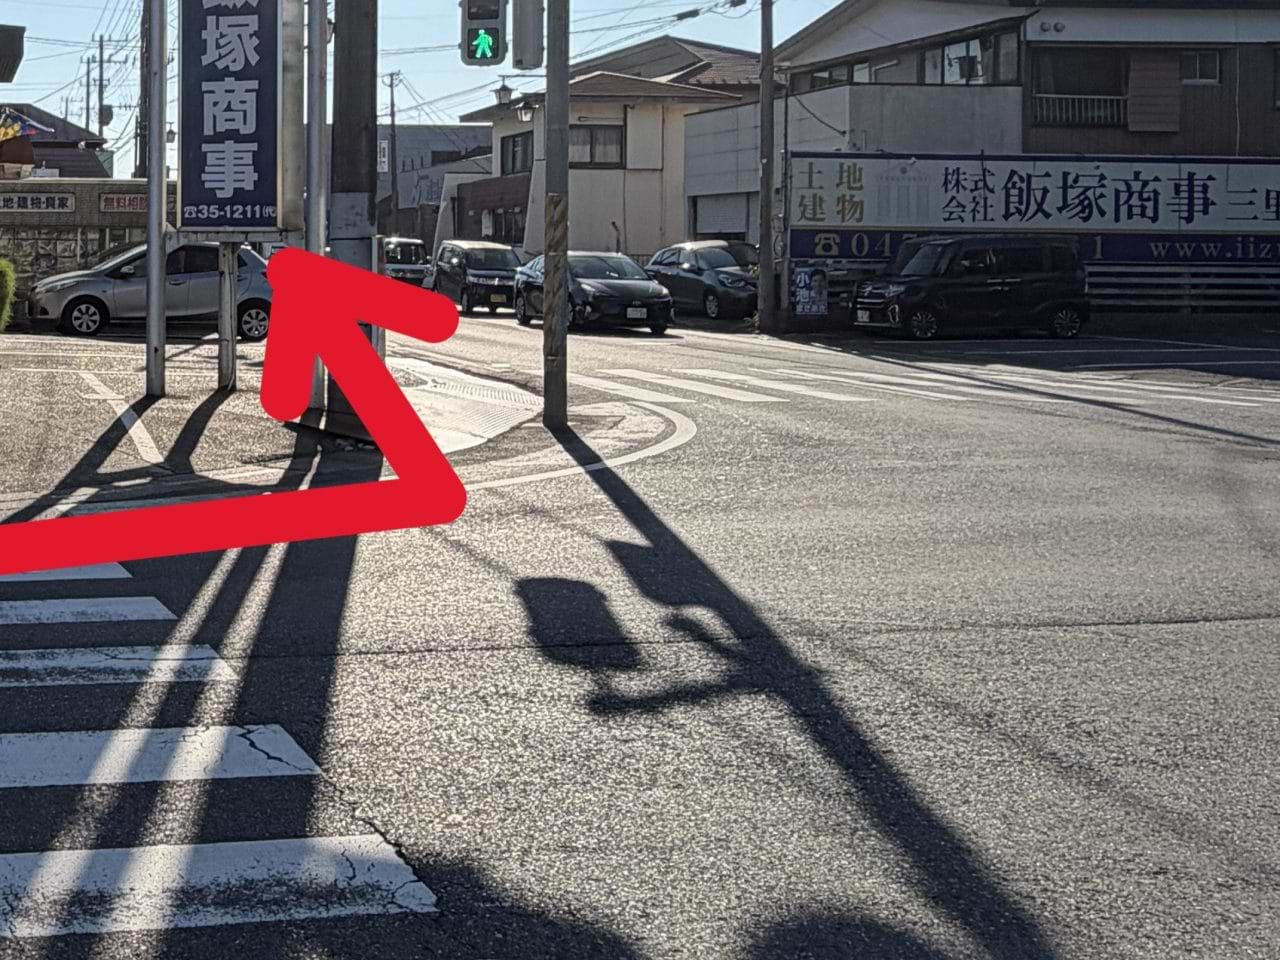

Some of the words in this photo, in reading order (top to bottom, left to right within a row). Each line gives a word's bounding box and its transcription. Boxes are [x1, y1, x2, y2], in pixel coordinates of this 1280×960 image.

[797, 162, 865, 192] 土地
[941, 166, 996, 195] 株式
[797, 194, 865, 223] 建物
[941, 196, 996, 223] 会社
[1001, 169, 1217, 225] 飯塚商事
[1150, 236, 1280, 258] www.iiz
